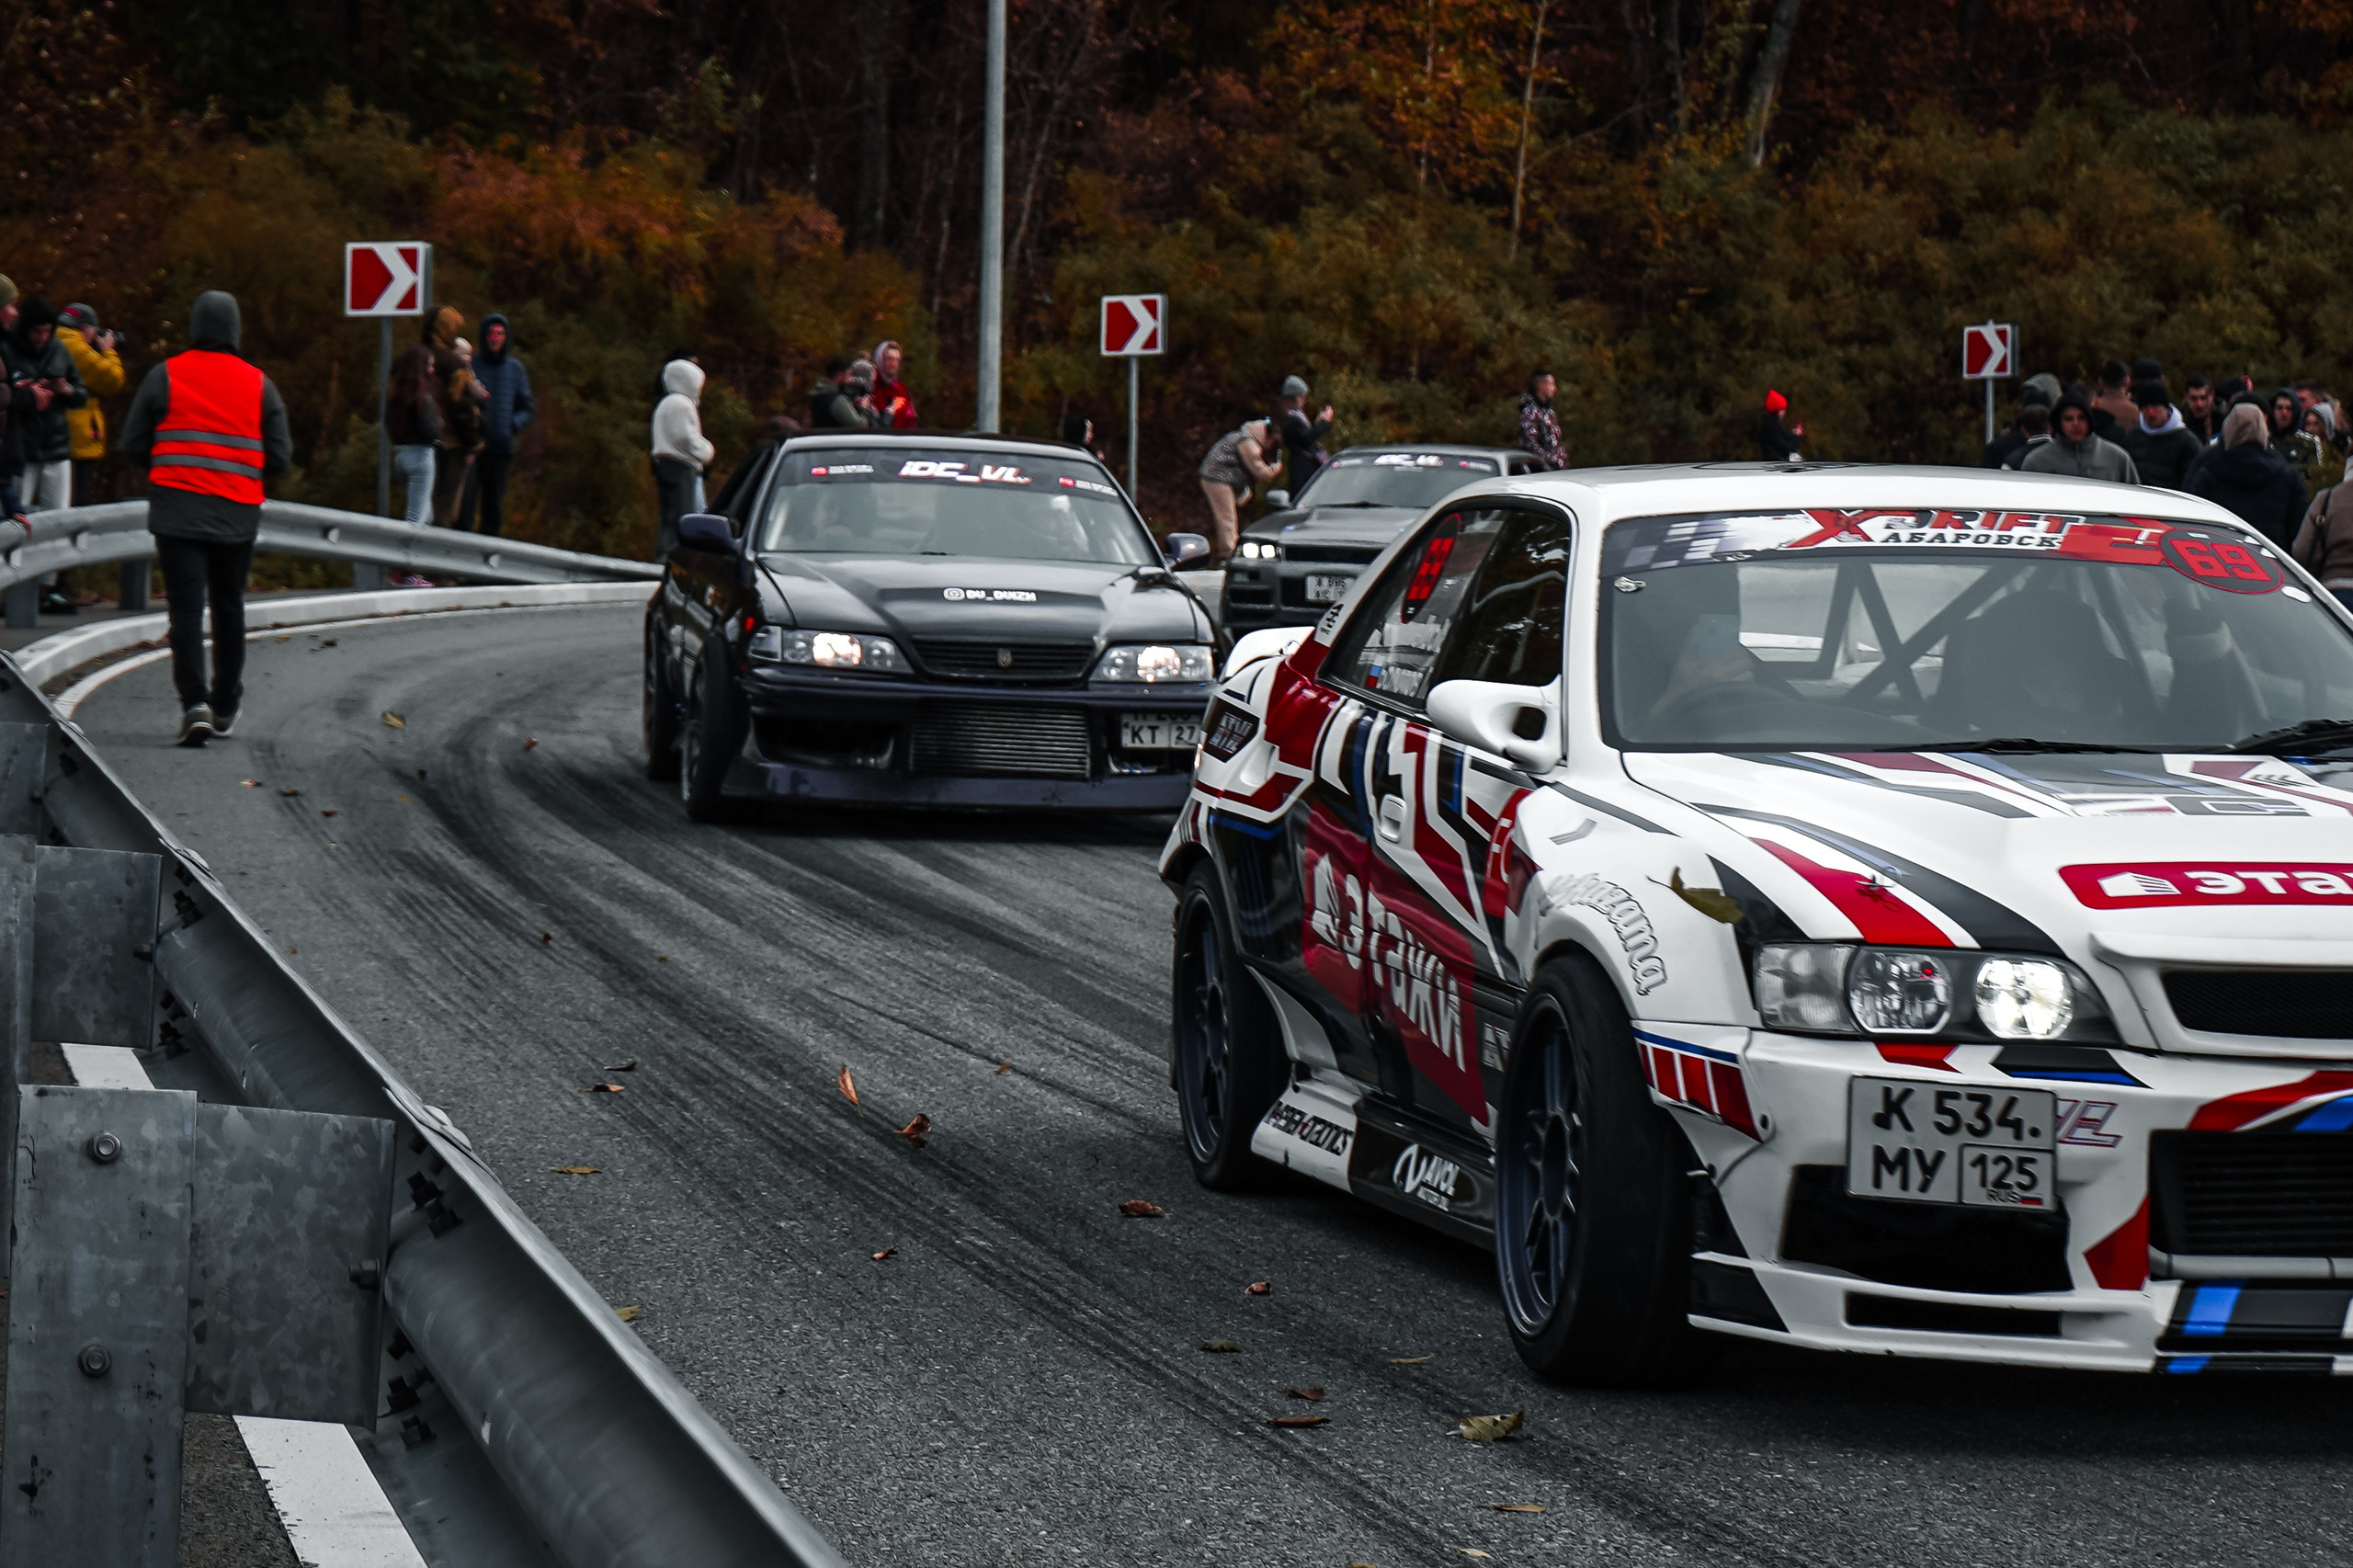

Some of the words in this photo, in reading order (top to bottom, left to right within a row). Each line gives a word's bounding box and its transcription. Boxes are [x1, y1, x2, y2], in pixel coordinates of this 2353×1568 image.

[2168, 539, 2273, 582] 69
[2184, 871, 2353, 896] эта
[1881, 1085, 1915, 1132] К
[1933, 1090, 2024, 1141] 534
[1871, 1143, 1947, 1193] МУ
[1970, 1152, 2039, 1191] 125
[1986, 1188, 2020, 1203] RUS
